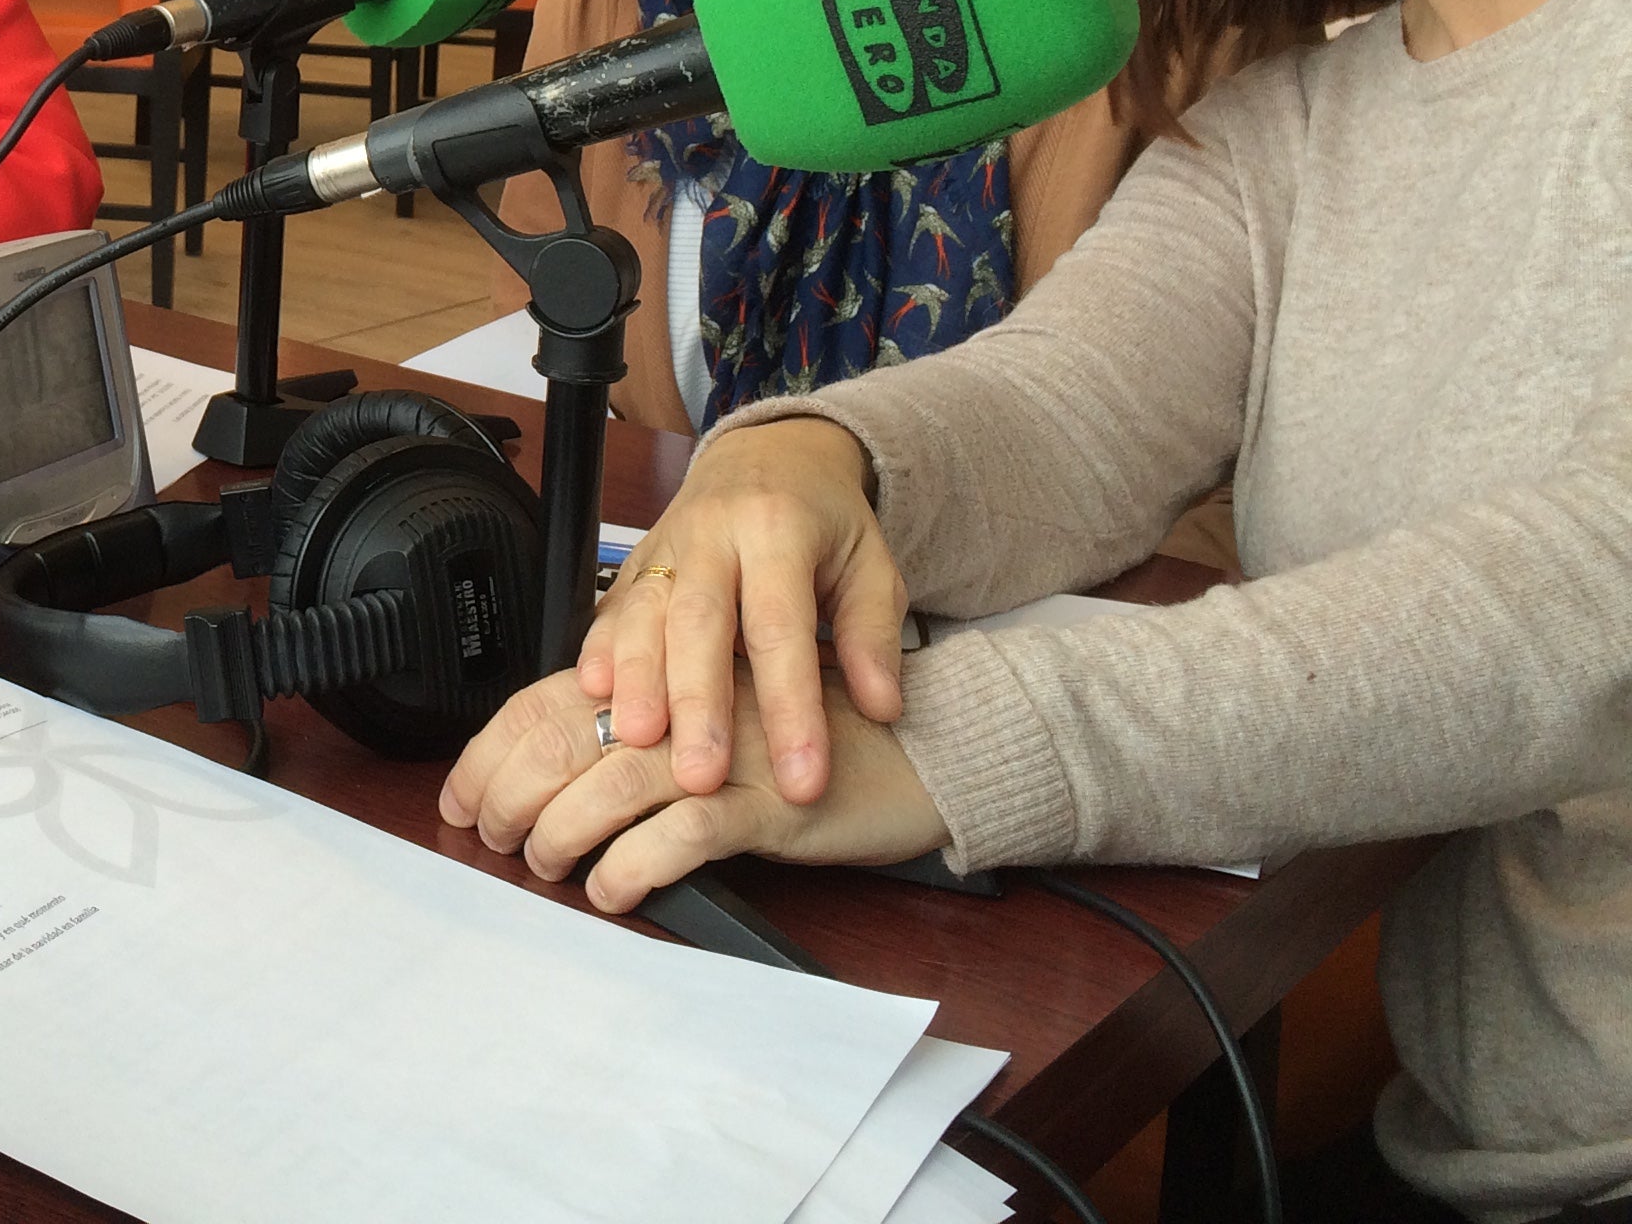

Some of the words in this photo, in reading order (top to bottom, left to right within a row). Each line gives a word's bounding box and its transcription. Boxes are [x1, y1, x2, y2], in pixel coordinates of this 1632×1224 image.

[461, 579, 482, 658] MAESTRO
[2, 926, 17, 936] en
[29, 896, 66, 919] momento
[11, 951, 27, 961] de
[19, 947, 35, 956] la
[31, 927, 64, 949] navidad
[60, 921, 76, 931] en
[69, 906, 99, 924] familia
